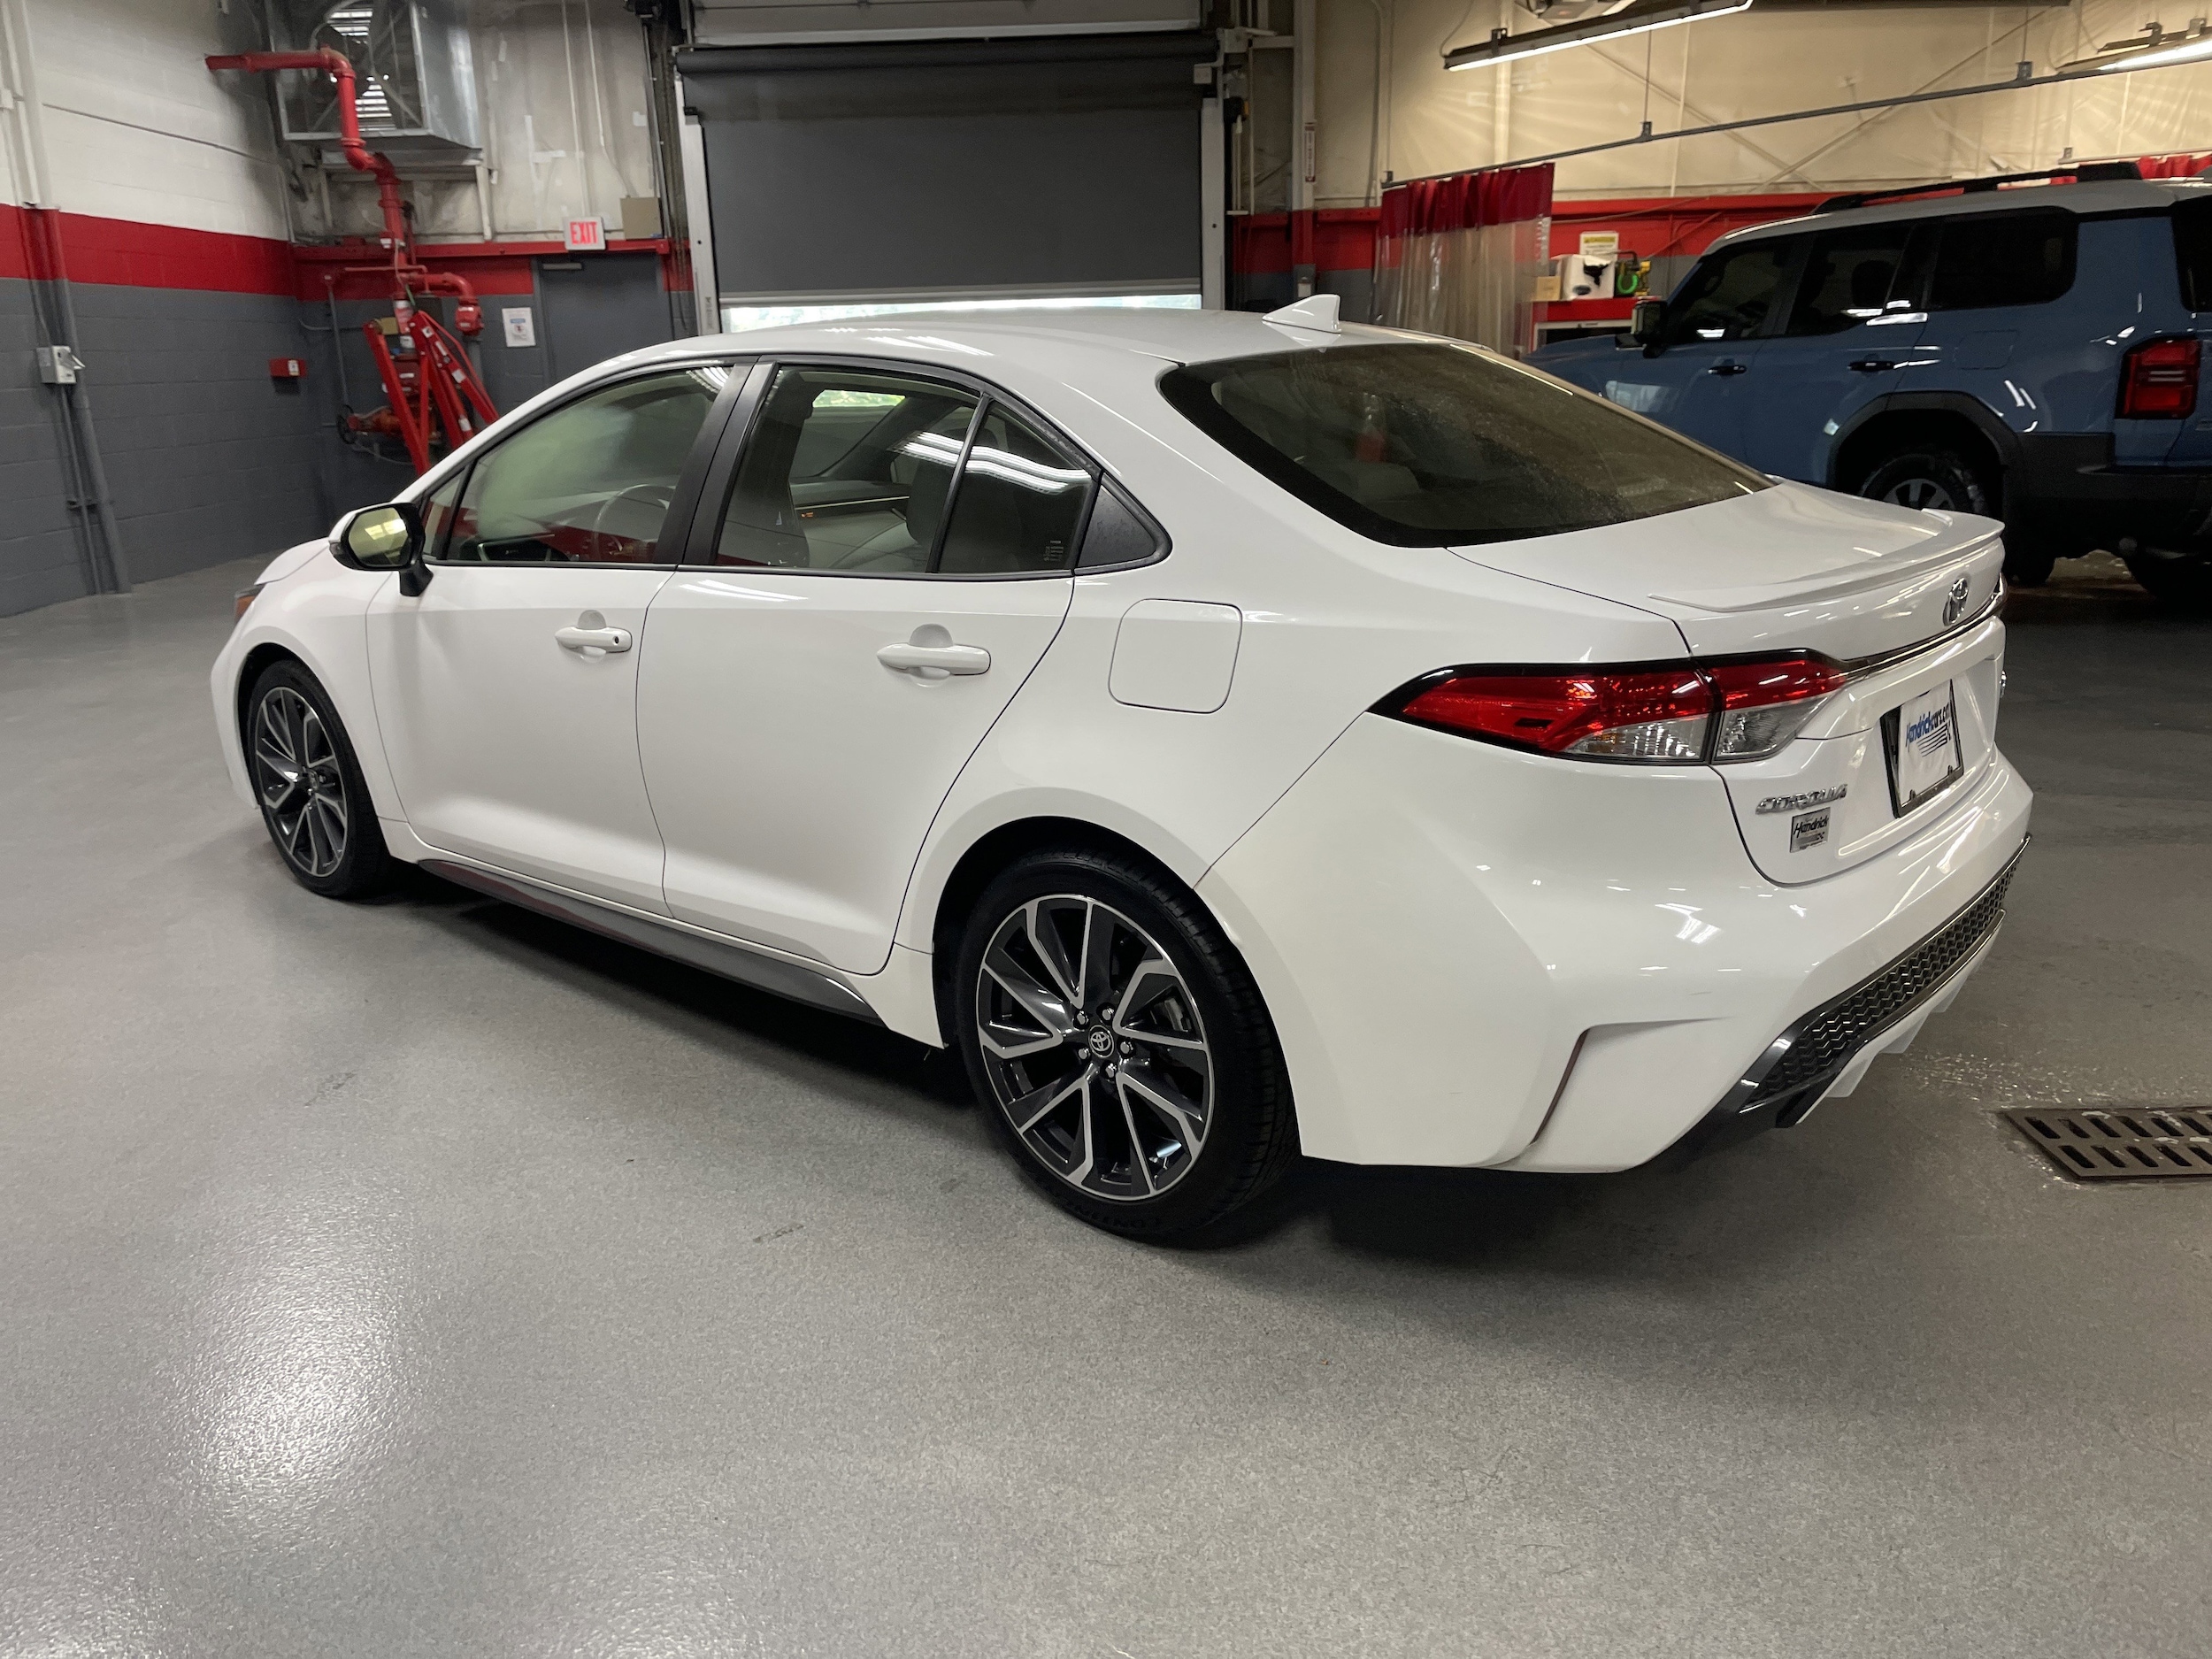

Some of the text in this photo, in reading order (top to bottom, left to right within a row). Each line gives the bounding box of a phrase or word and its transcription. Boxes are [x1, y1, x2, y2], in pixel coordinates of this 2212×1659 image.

[570, 220, 598, 245] EXIT
[1755, 784, 1847, 815] COROLLA
[1793, 815, 1830, 838] Hendrick
